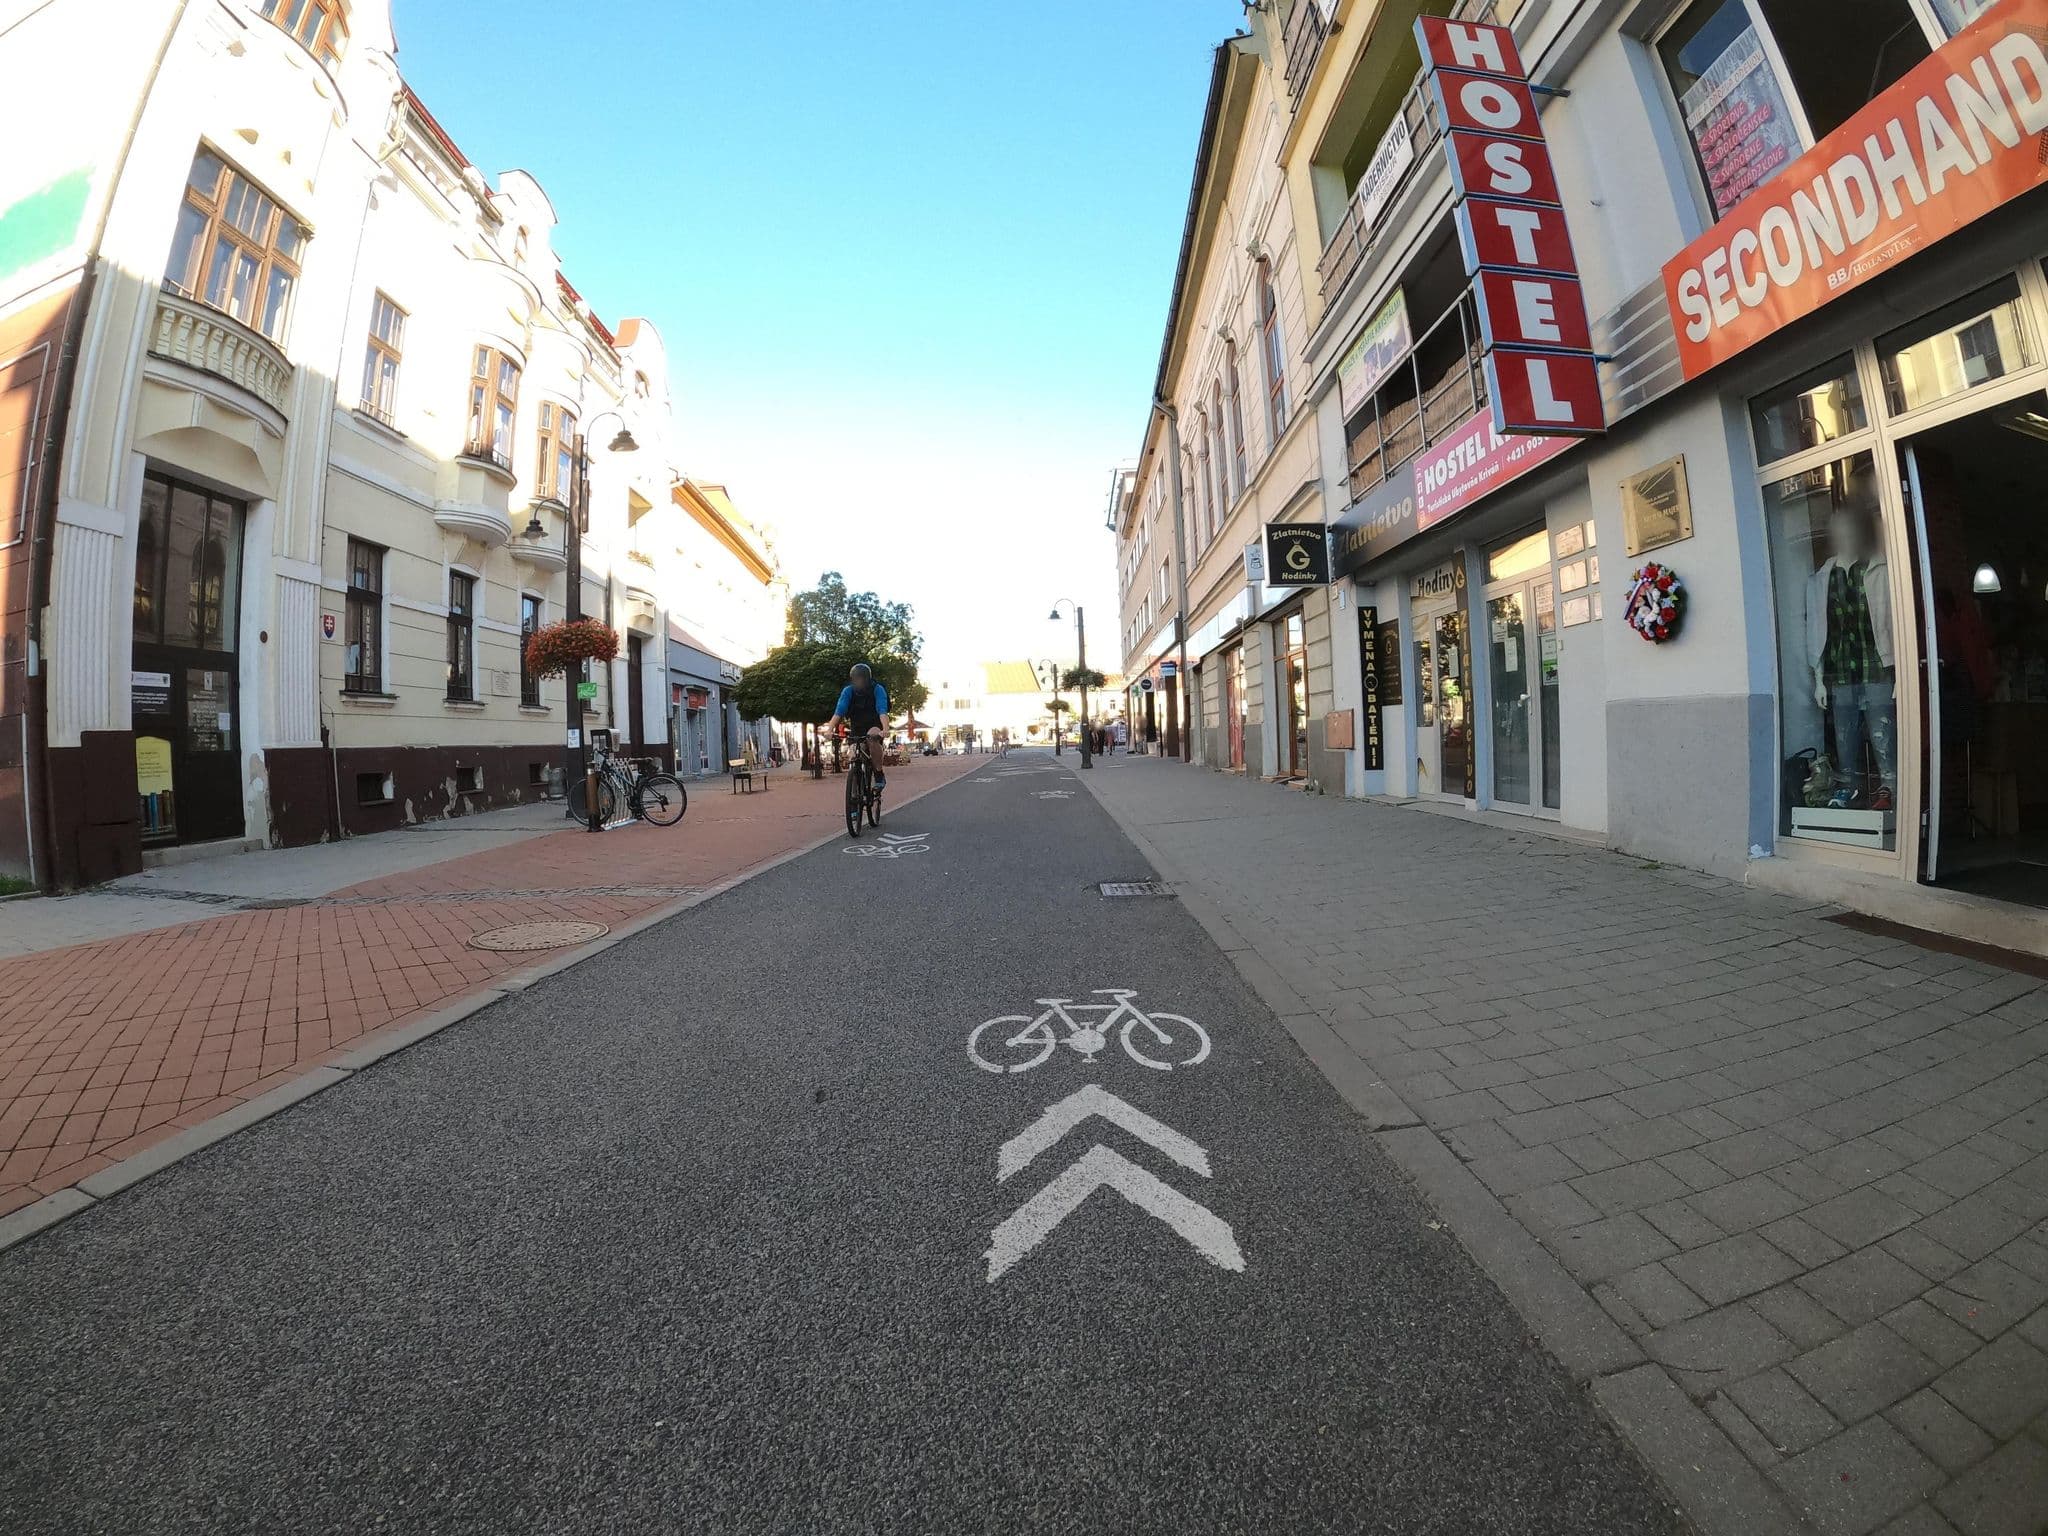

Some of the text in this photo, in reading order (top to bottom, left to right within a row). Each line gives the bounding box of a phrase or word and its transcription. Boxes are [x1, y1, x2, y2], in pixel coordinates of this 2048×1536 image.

[1677, 32, 2048, 343] SECONDHAND
[1446, 23, 1574, 422] HOSTEL
[1424, 431, 1486, 495] HOSTEL
[1506, 445, 1525, 463] +421
[1272, 528, 1321, 540] Zlatníctvo
[1282, 571, 1317, 581] Hodinky
[1418, 568, 1455, 598] Hodiny
